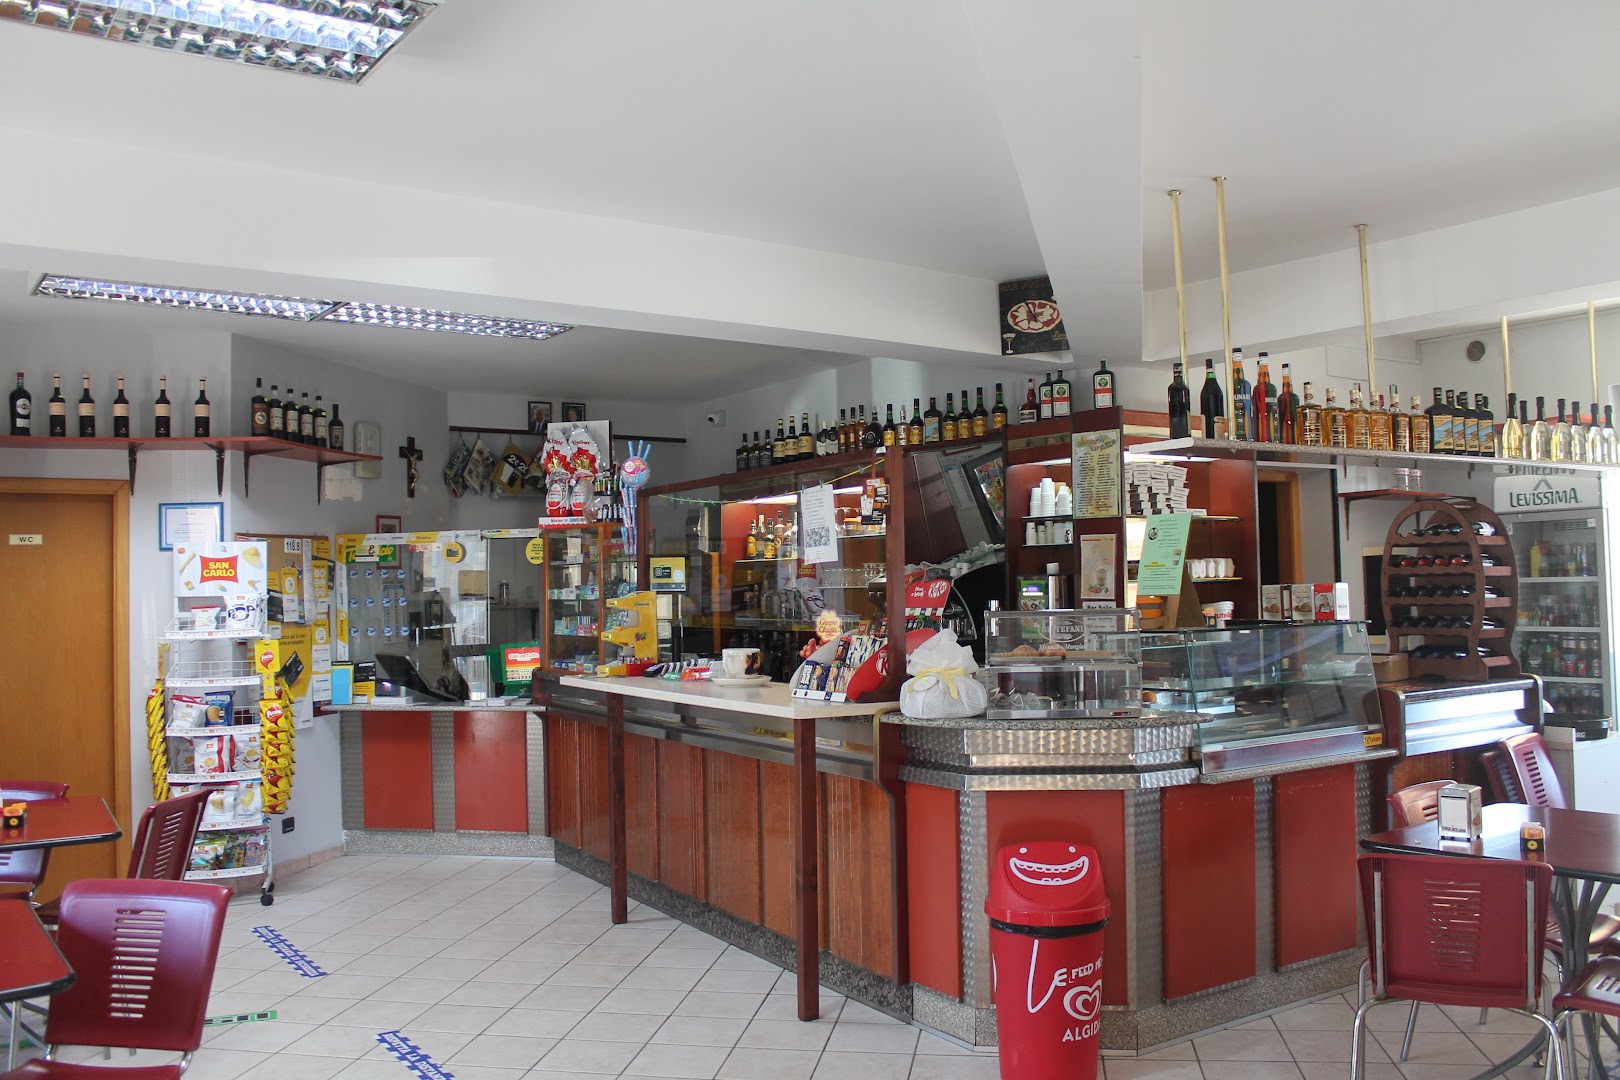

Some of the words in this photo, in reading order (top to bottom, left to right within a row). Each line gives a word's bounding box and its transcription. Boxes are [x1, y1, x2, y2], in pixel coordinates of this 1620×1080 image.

[1509, 487, 1579, 508] LEVISSIMA
[19, 535, 33, 544] WC
[208, 561, 229, 569] SAN
[203, 569, 235, 577] CARLO
[1072, 963, 1094, 979] FEED
